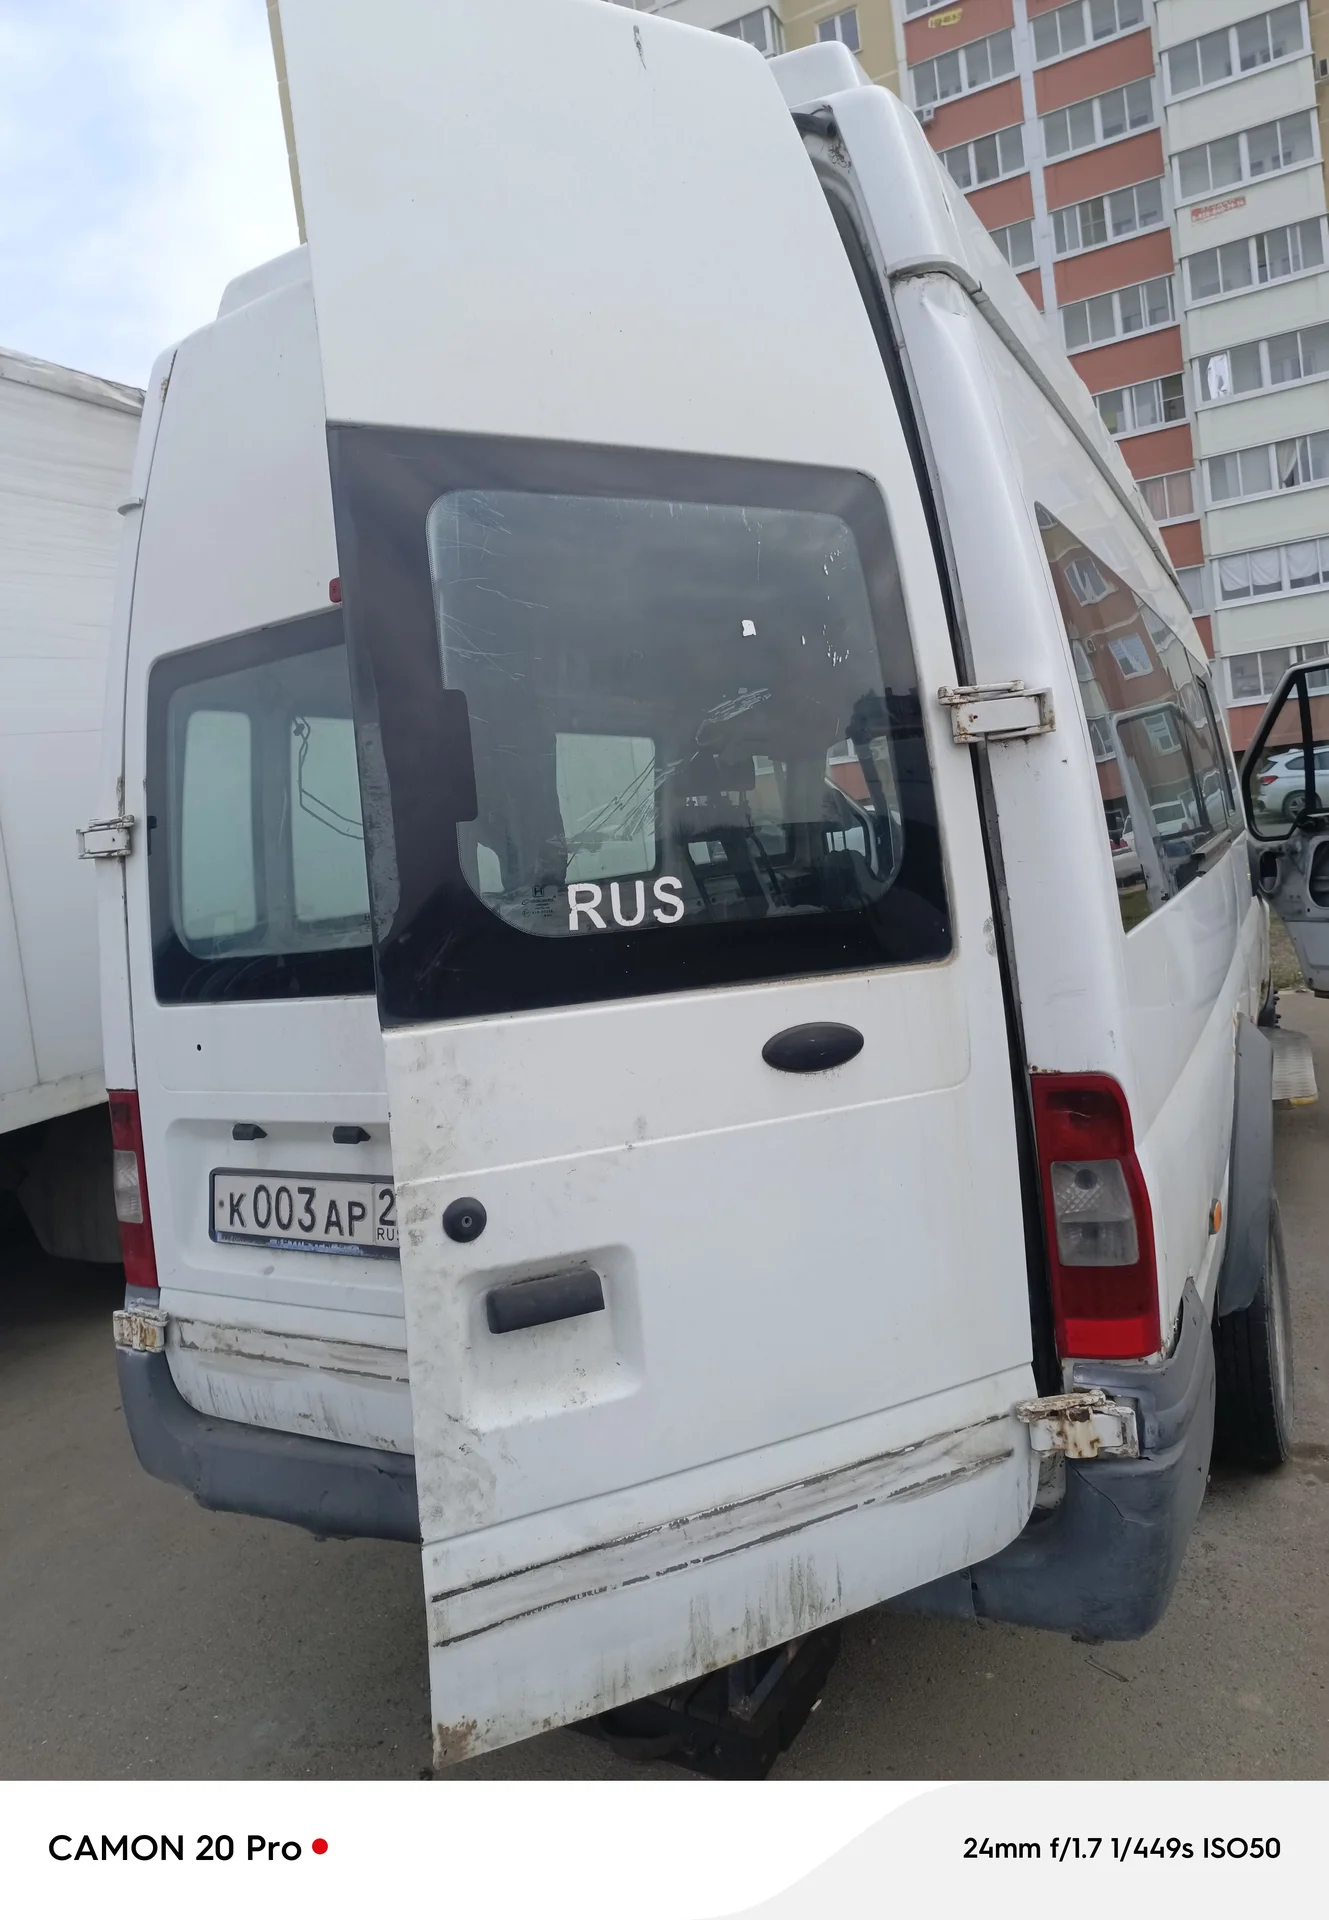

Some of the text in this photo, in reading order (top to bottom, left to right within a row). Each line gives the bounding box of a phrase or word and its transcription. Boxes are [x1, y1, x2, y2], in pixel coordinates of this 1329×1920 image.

[567, 876, 685, 931] RUS
[378, 1188, 396, 1226] 2
[377, 1227, 399, 1241] RU
